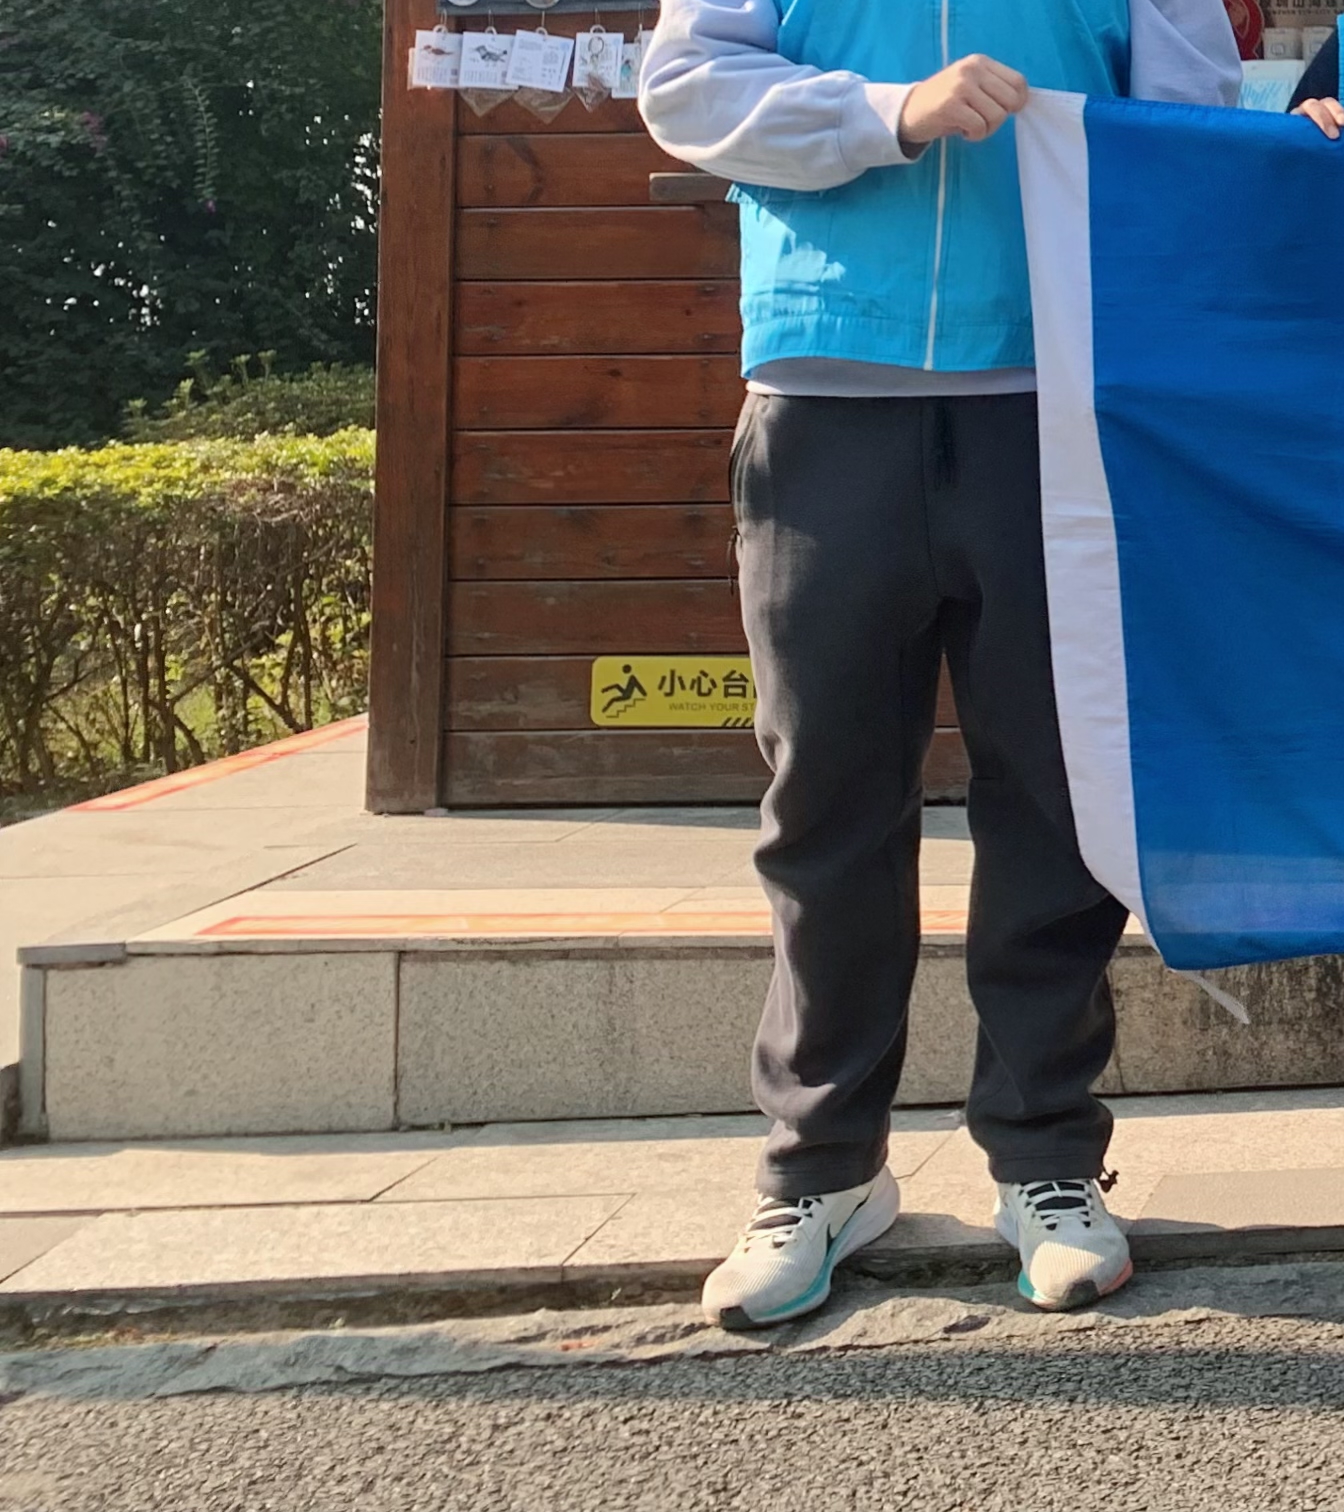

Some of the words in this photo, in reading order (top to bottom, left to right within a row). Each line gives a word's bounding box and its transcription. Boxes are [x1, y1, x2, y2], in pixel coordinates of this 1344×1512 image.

[657, 669, 757, 698] 小心台
[669, 702, 706, 712] WATCH
[709, 702, 740, 712] YOUR
